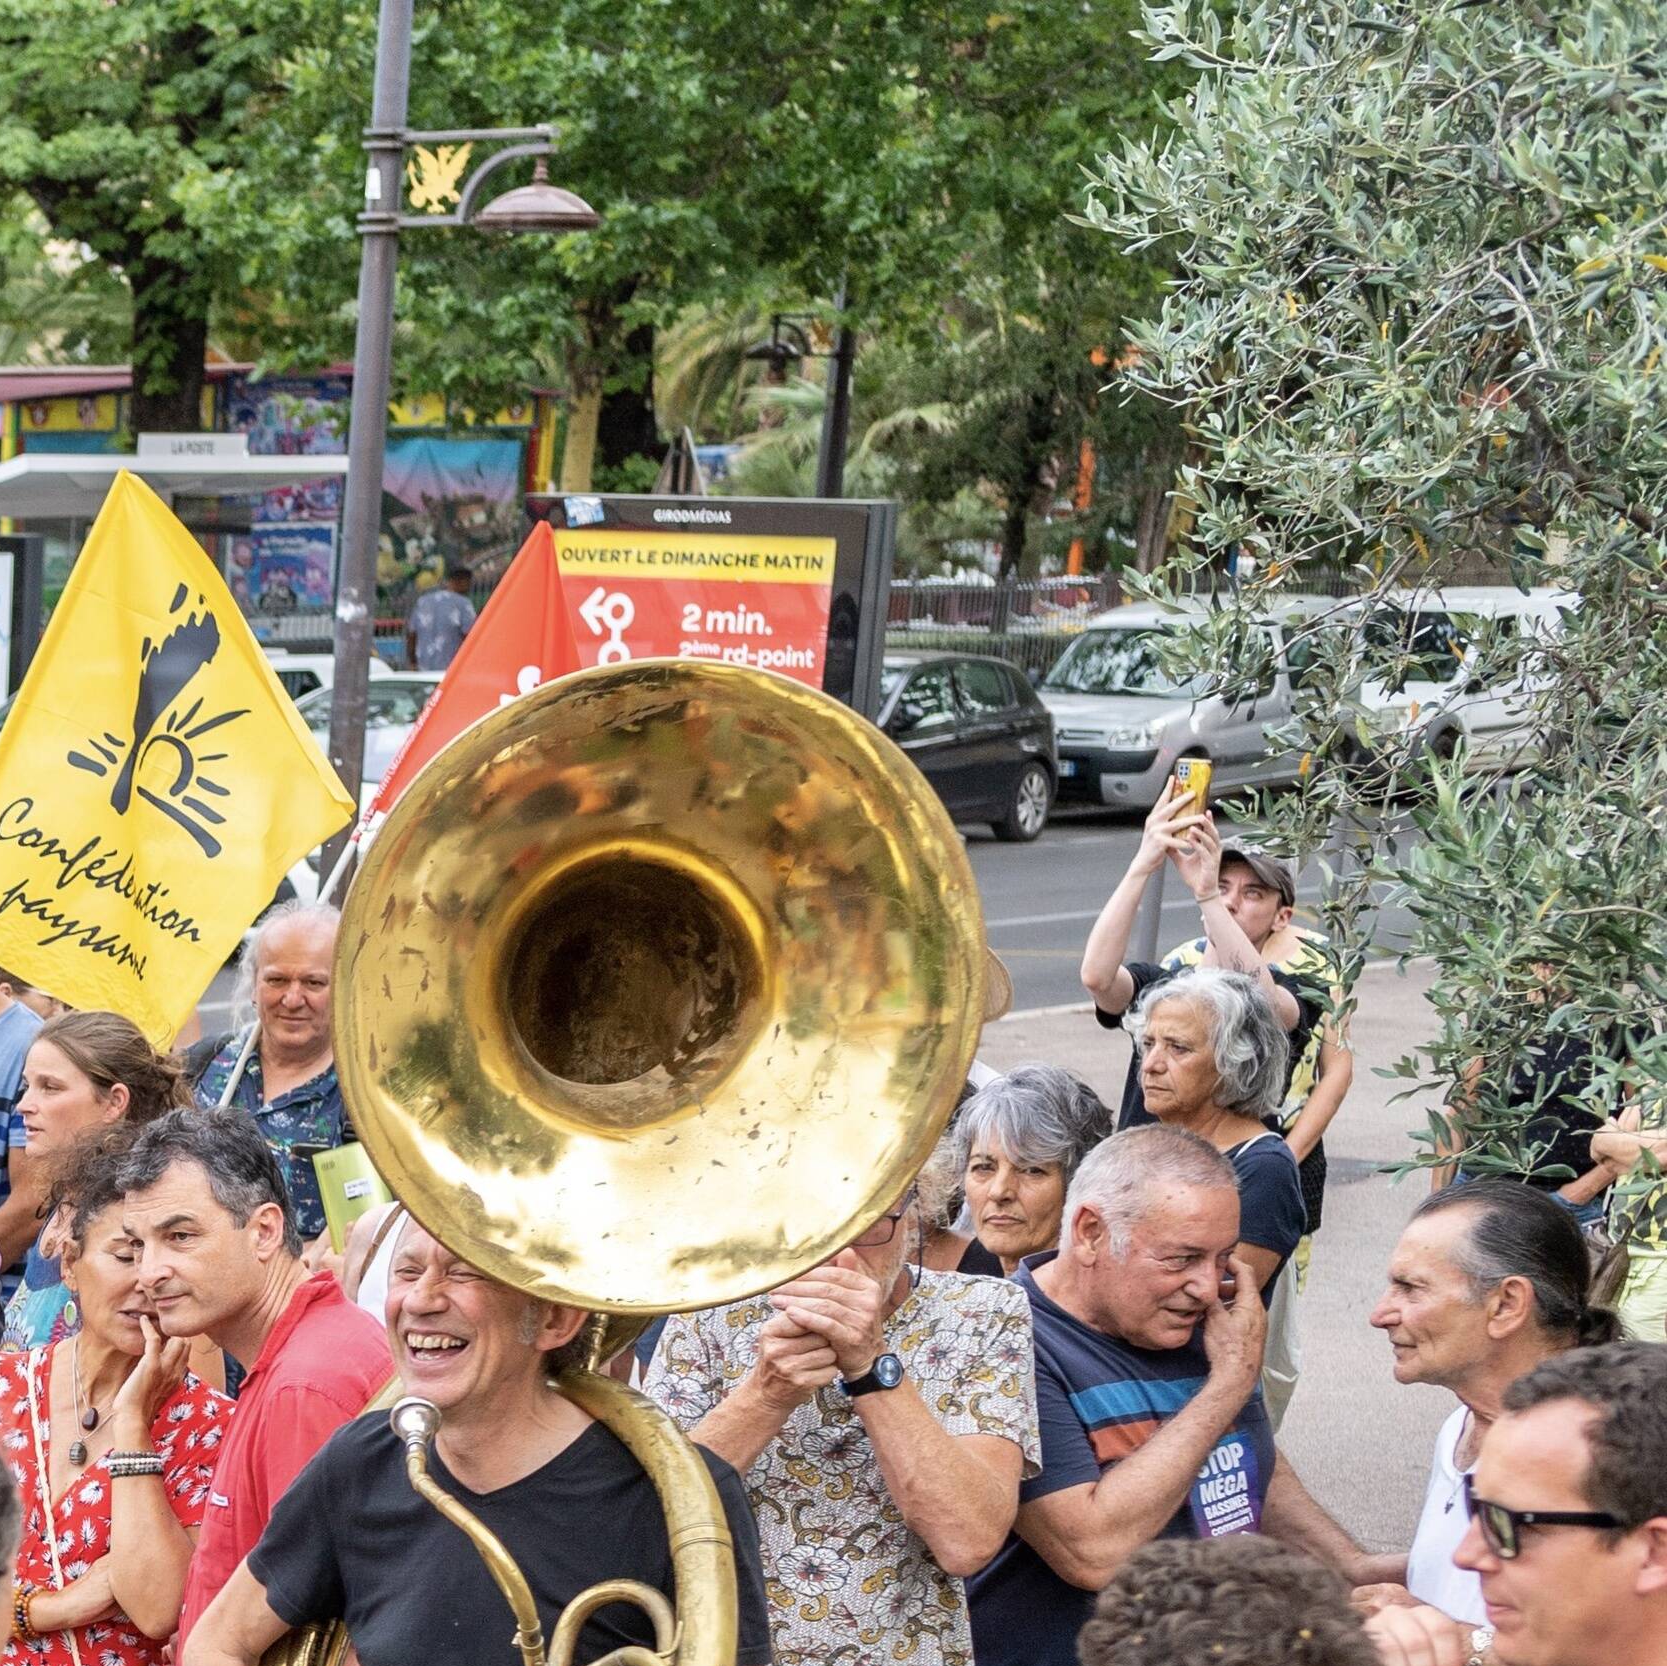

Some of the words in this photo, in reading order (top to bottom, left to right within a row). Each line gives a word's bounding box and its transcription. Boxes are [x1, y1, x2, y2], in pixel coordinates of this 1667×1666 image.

[561, 547, 632, 564] OUVERT
[636, 550, 656, 564] LE
[662, 551, 759, 568] DIMANCHE
[764, 554, 824, 570] MATIN
[681, 603, 701, 632] 2
[706, 604, 773, 635] min.
[1199, 1471, 1248, 1505] MÉGA
